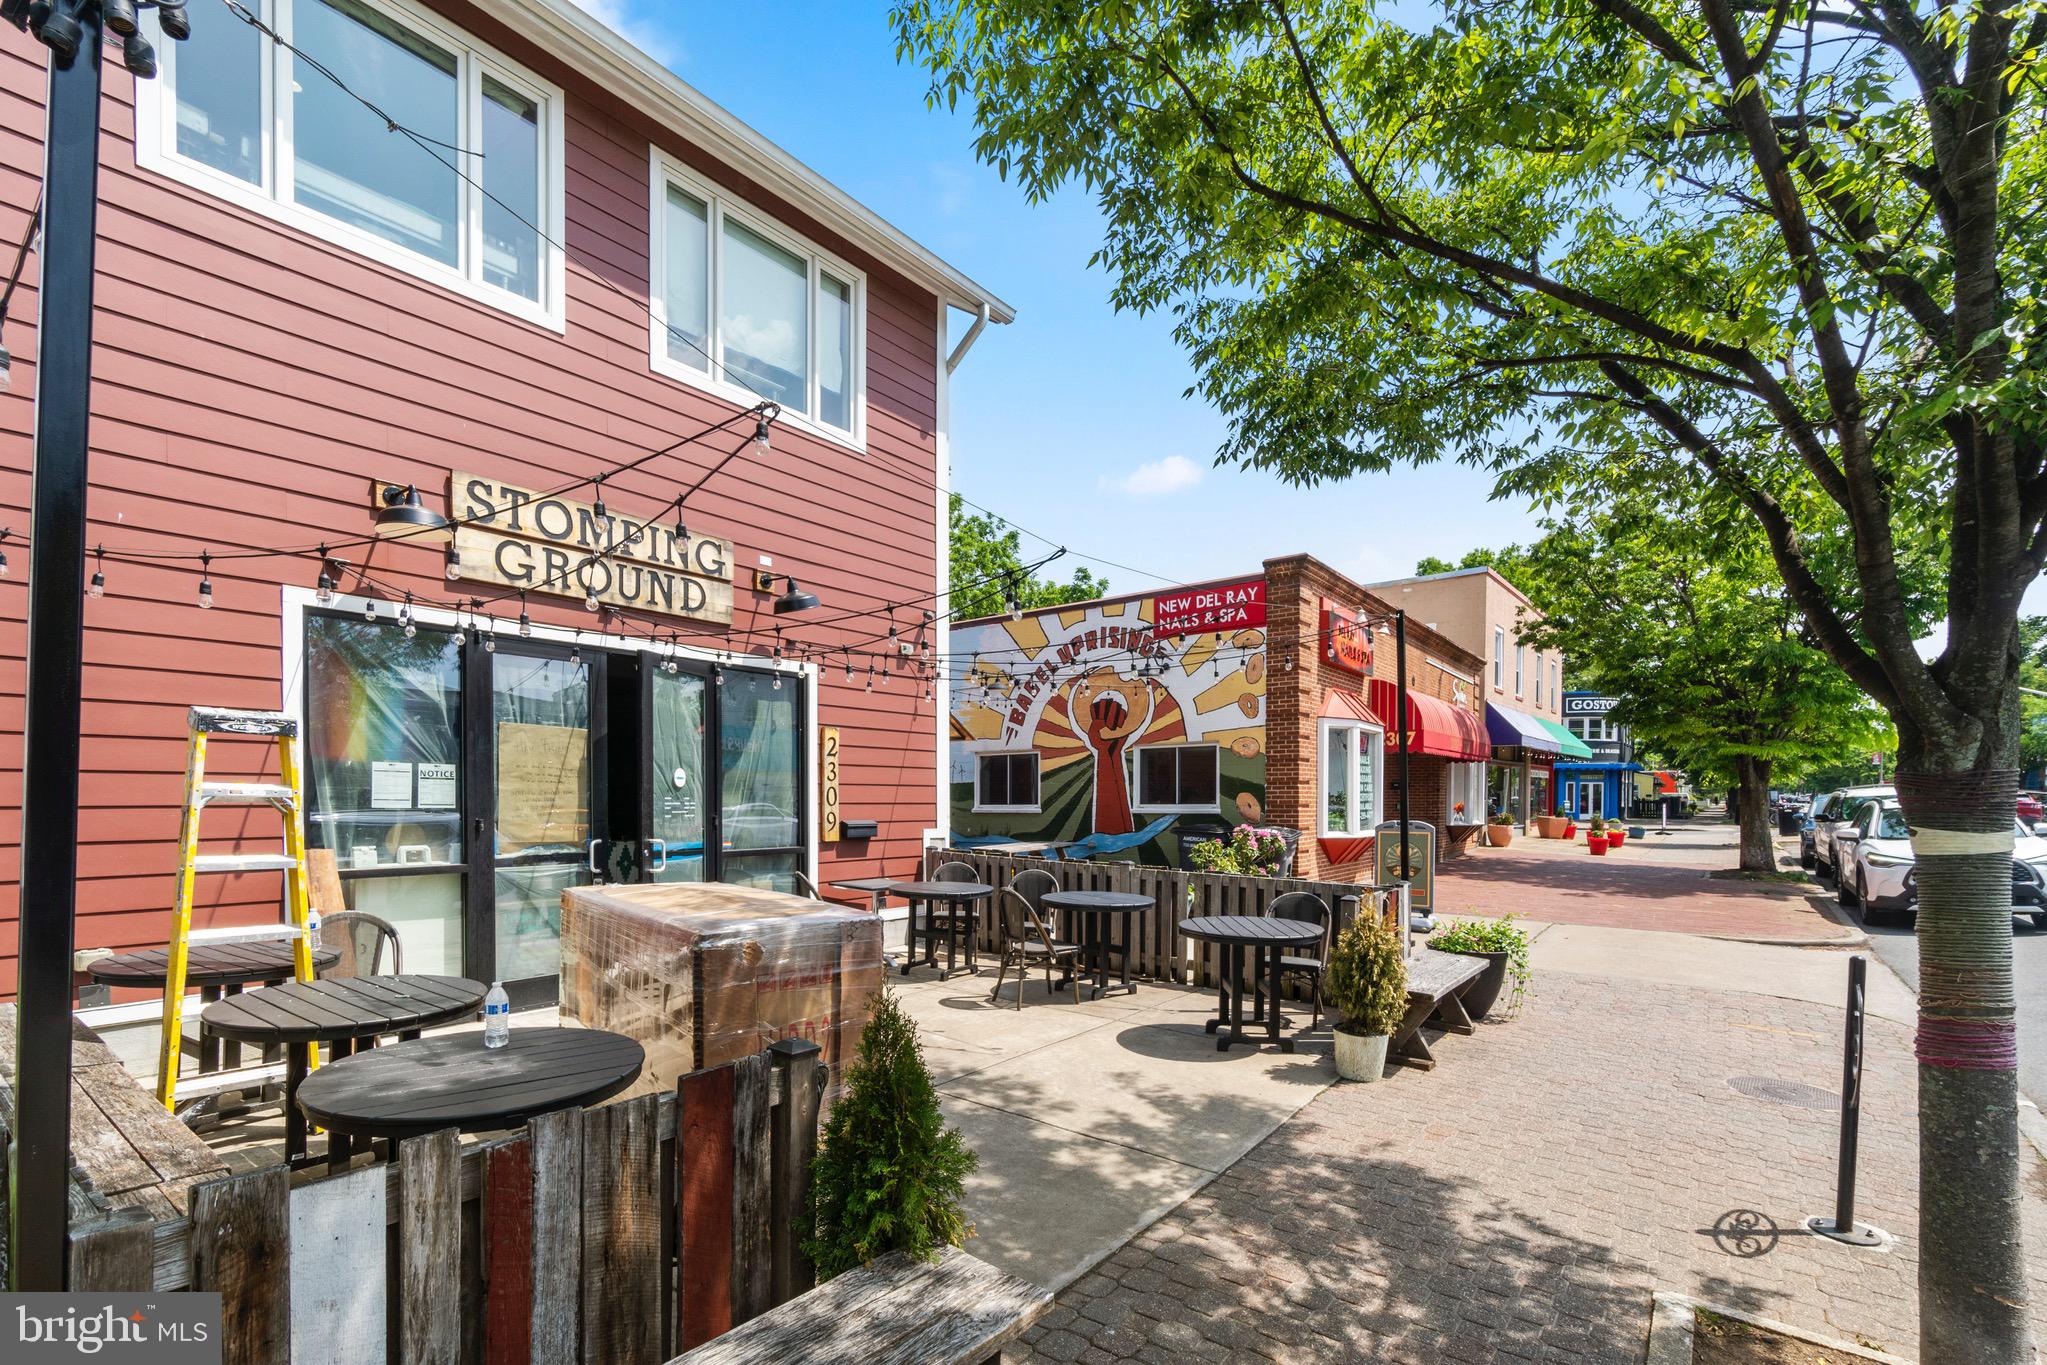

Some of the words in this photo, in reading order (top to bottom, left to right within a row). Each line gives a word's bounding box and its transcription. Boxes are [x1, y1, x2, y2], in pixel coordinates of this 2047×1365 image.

[466, 478, 727, 577] STOMPING
[495, 539, 707, 612] GROUND
[1159, 596, 1192, 614] NEW
[1196, 593, 1222, 609] DEL
[1226, 586, 1258, 604] RAY
[1159, 612, 1200, 631] NAILS
[1204, 611, 1216, 624] &
[1219, 607, 1248, 622] SPA
[1008, 658, 1059, 726] BAGEL
[419, 769, 454, 778] NOTICE
[826, 736, 839, 832] 2309
